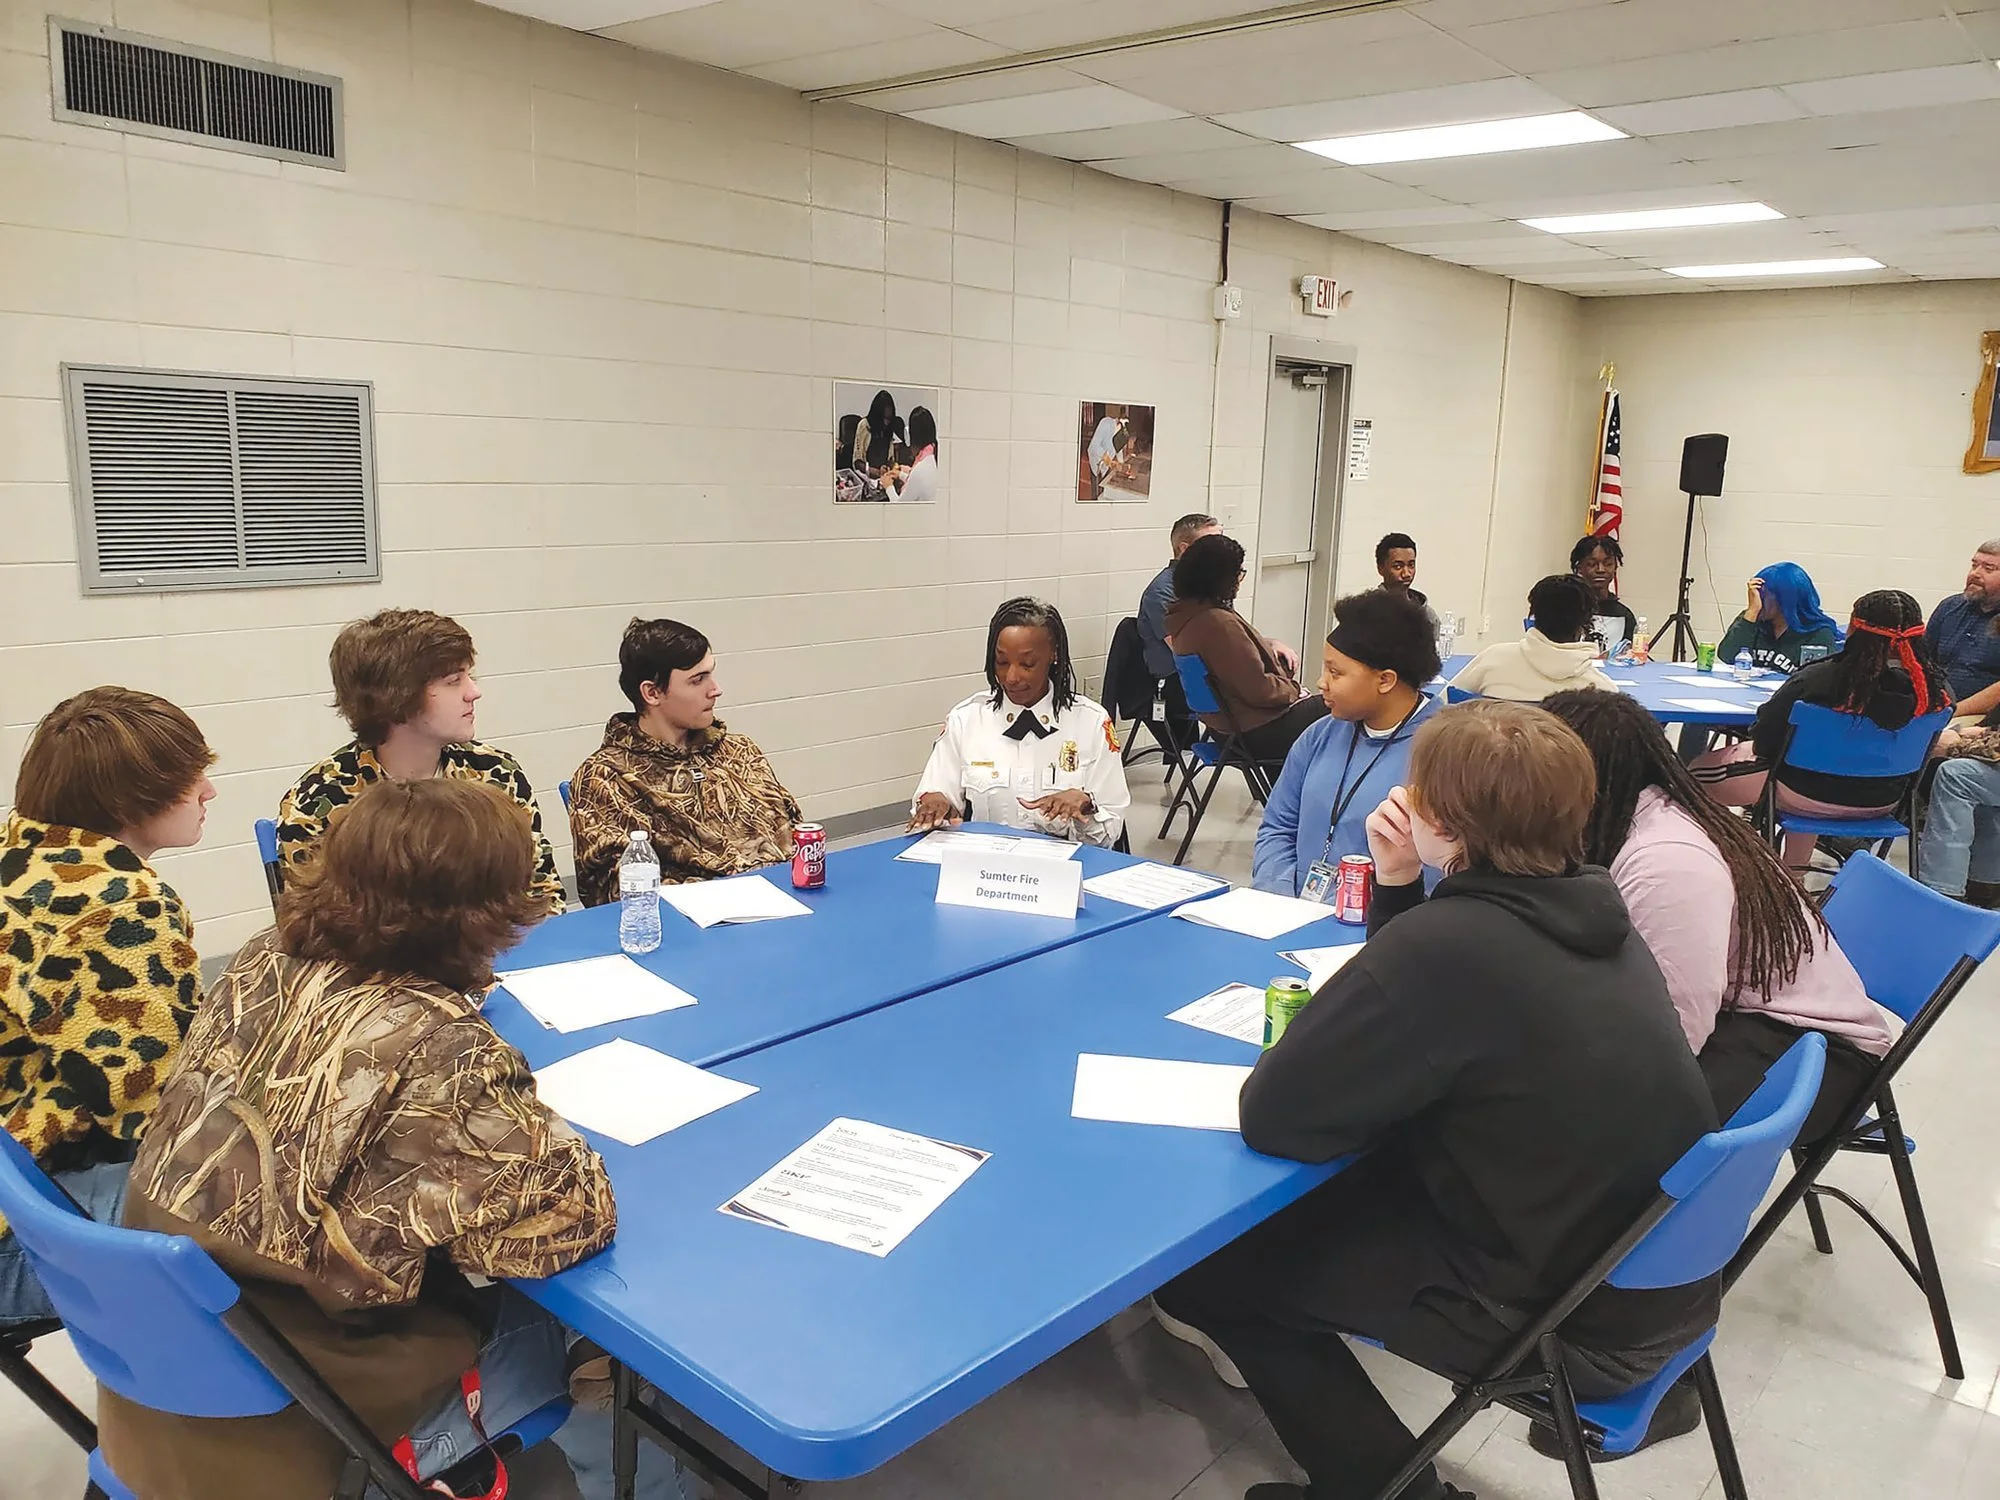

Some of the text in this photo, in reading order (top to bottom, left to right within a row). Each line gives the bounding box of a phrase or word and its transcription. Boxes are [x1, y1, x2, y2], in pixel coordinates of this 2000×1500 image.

[1317, 278, 1337, 310] EXIT
[980, 869, 1040, 885] Sumter Fire
[976, 886, 1039, 903] Department
